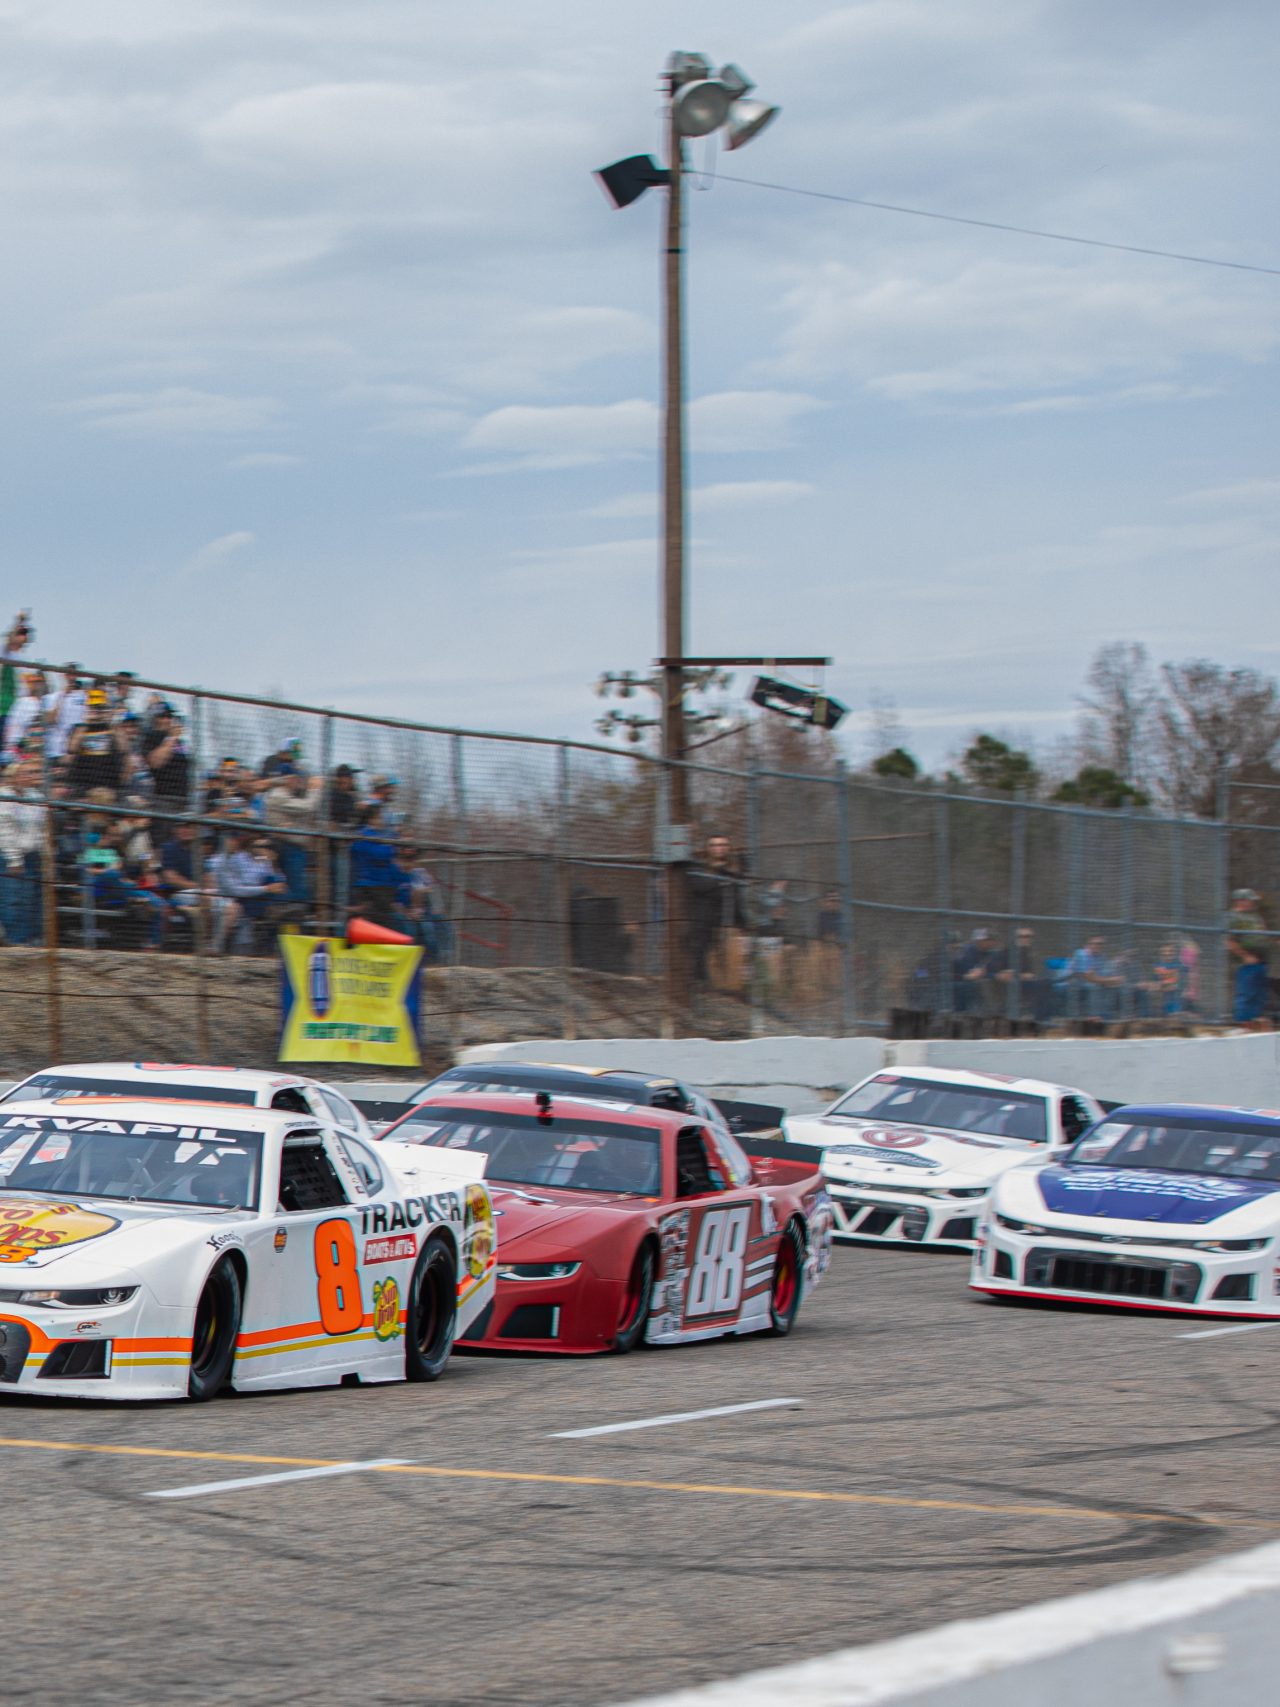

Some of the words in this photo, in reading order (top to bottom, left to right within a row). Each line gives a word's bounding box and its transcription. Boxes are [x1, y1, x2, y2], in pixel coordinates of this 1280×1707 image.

[3, 1116, 237, 1143] KVAPIL
[355, 1191, 462, 1235] TRACKER
[314, 1216, 364, 1336] 8
[687, 1206, 752, 1316] 88
